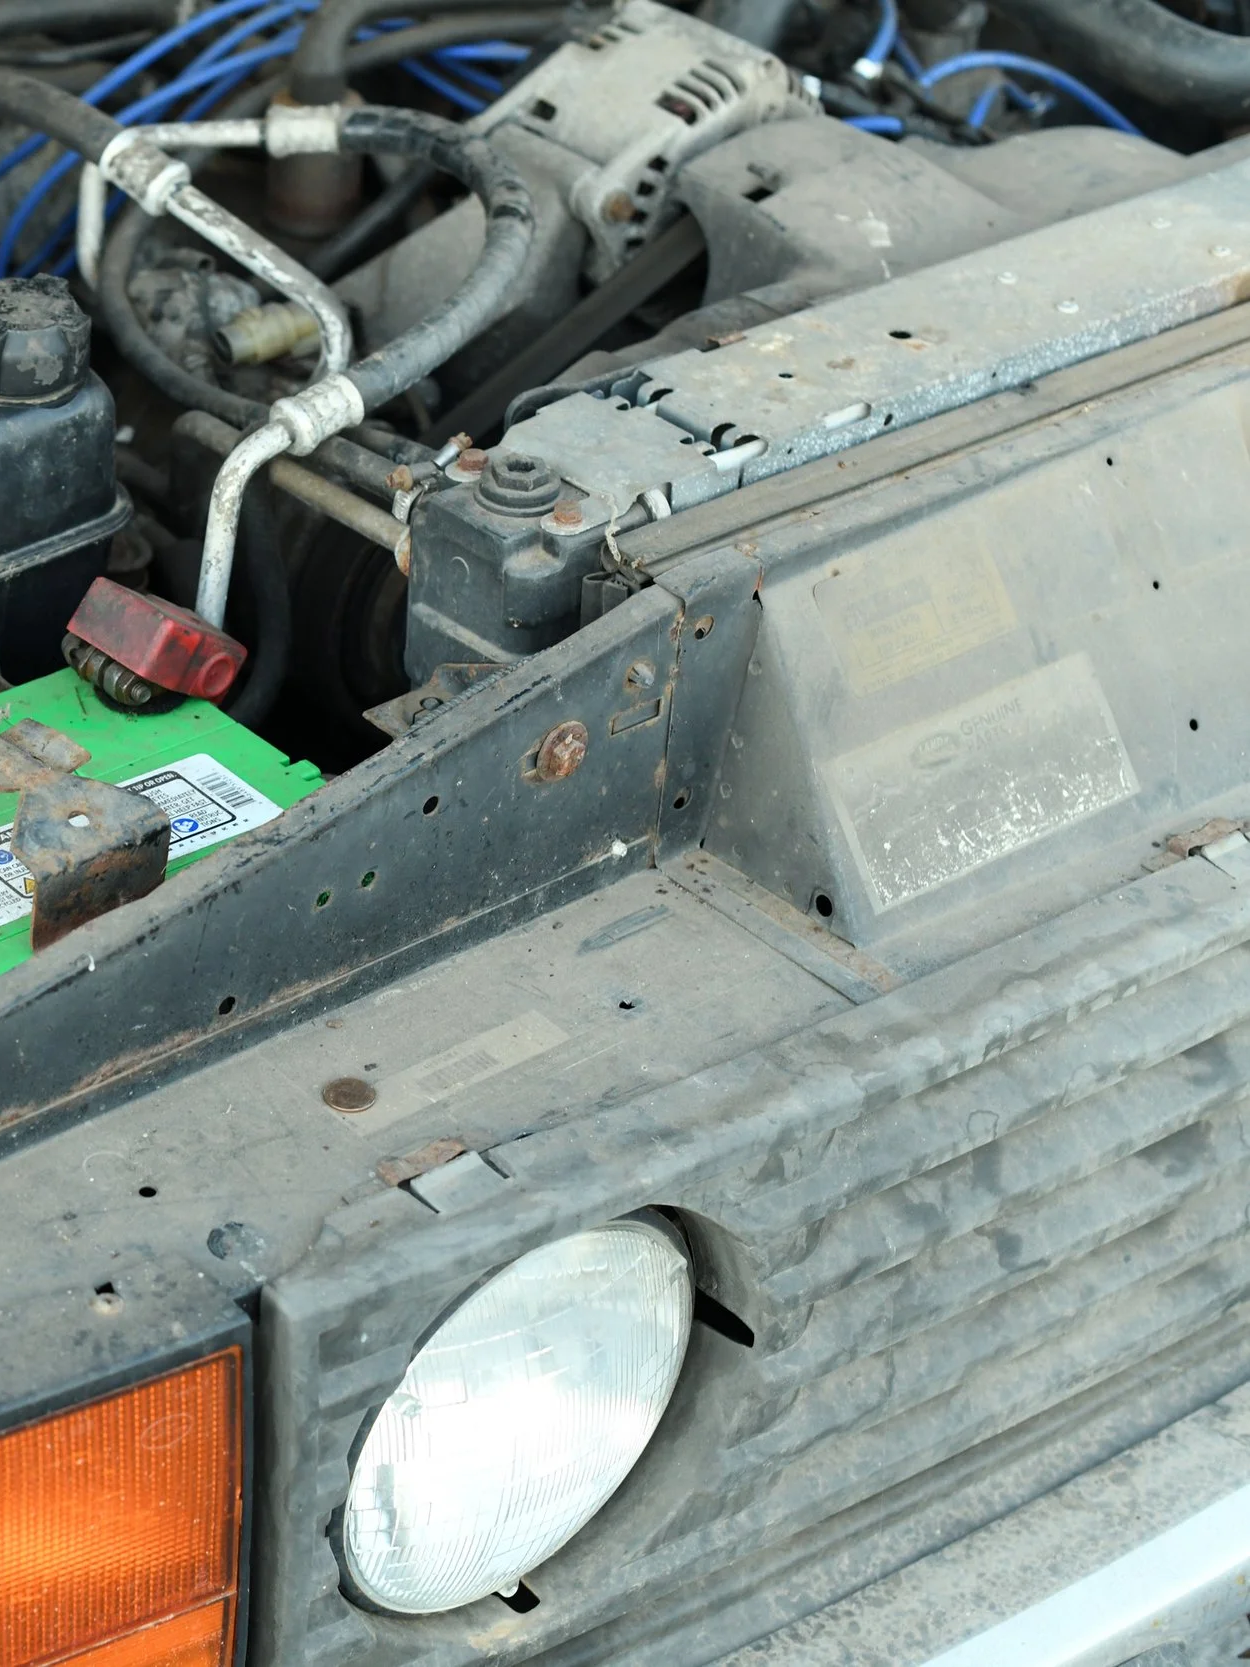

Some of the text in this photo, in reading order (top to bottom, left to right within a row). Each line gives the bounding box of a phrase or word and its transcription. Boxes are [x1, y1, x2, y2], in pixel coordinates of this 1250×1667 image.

[146, 789, 162, 797] USH
[157, 789, 196, 806] MMEDIATELY
[163, 802, 180, 811] ATER.
